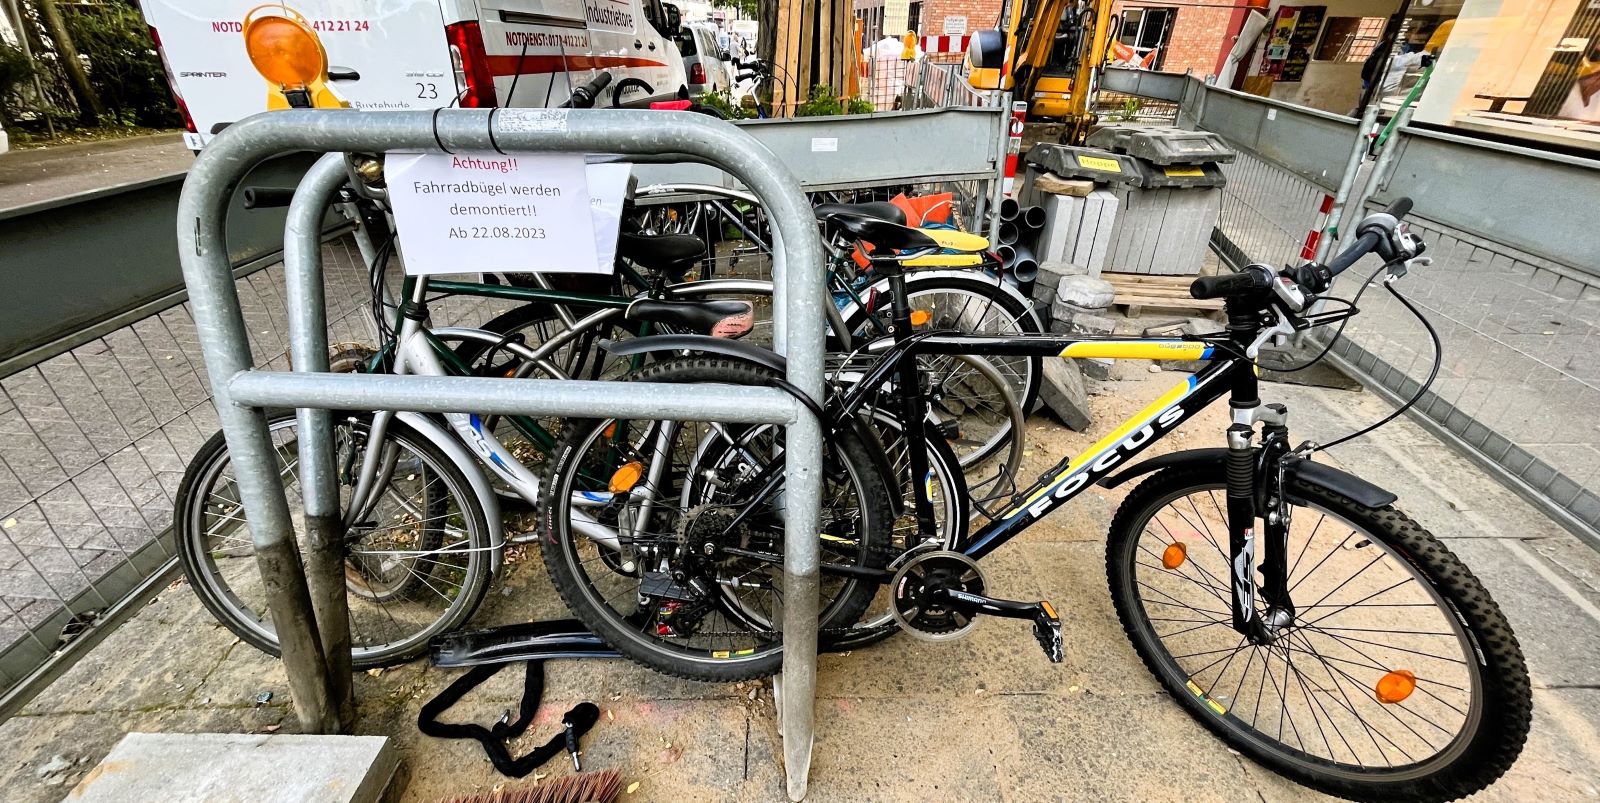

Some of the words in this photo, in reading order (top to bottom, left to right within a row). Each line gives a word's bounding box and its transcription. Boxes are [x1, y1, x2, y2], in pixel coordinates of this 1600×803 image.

[337, 20, 351, 31] 21
[354, 20, 370, 31] 24
[415, 82, 438, 99] 23
[452, 156, 518, 174] Achtung!!
[414, 181, 507, 195] Fahrradbügel
[510, 184, 561, 197] werden
[450, 203, 537, 217] demontiert!!
[449, 226, 468, 239] Ab
[471, 227, 546, 240] 22.08.2023
[1028, 404, 1185, 519] FOCUS
